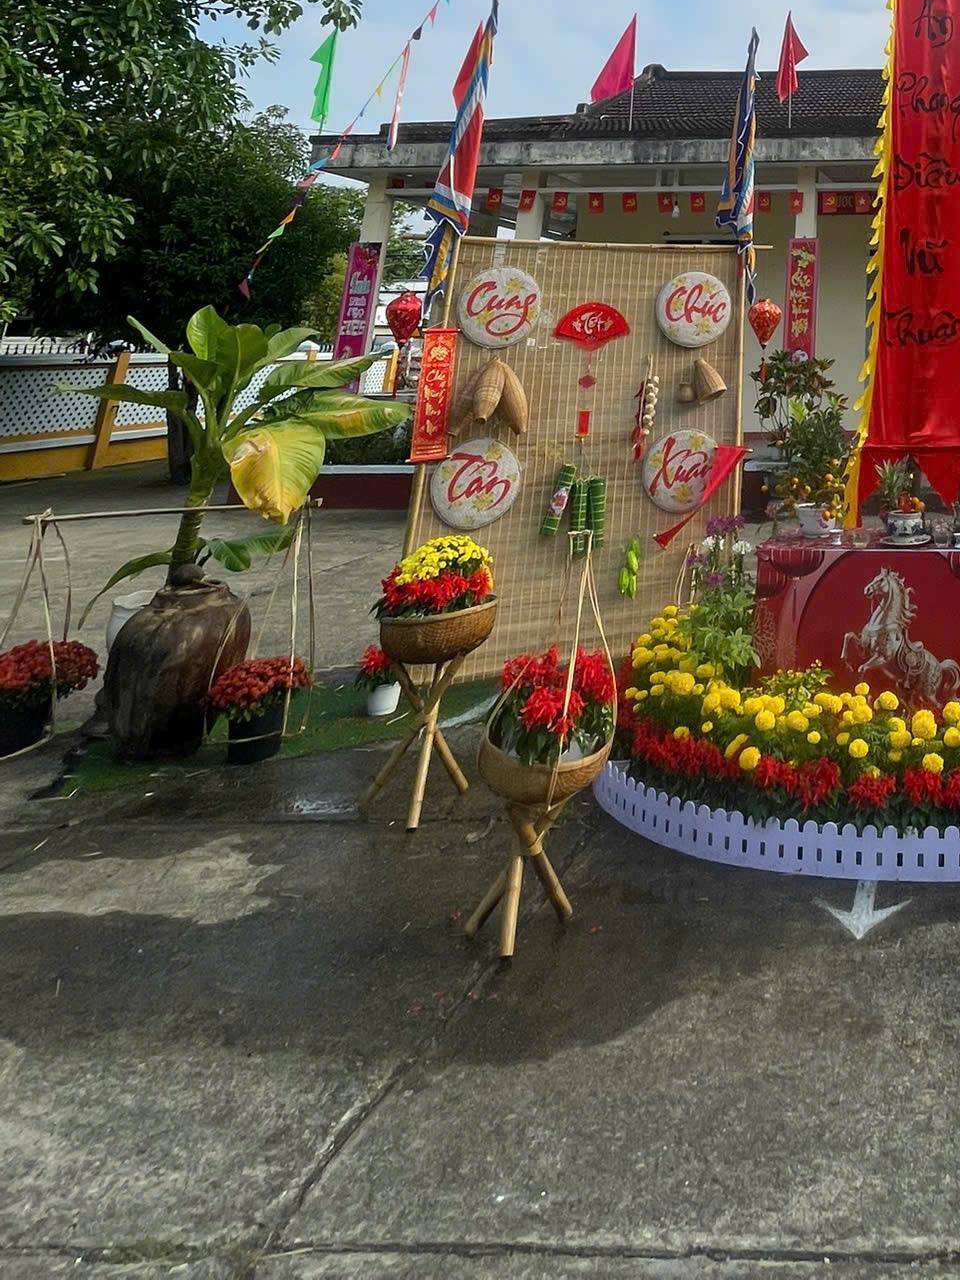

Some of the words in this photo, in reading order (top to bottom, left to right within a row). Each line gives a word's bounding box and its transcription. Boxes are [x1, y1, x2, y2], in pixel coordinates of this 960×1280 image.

[466, 281, 538, 336] Cung
[664, 283, 728, 324] Chúc
[448, 452, 512, 510] Tân
[650, 436, 714, 497] Xuân
